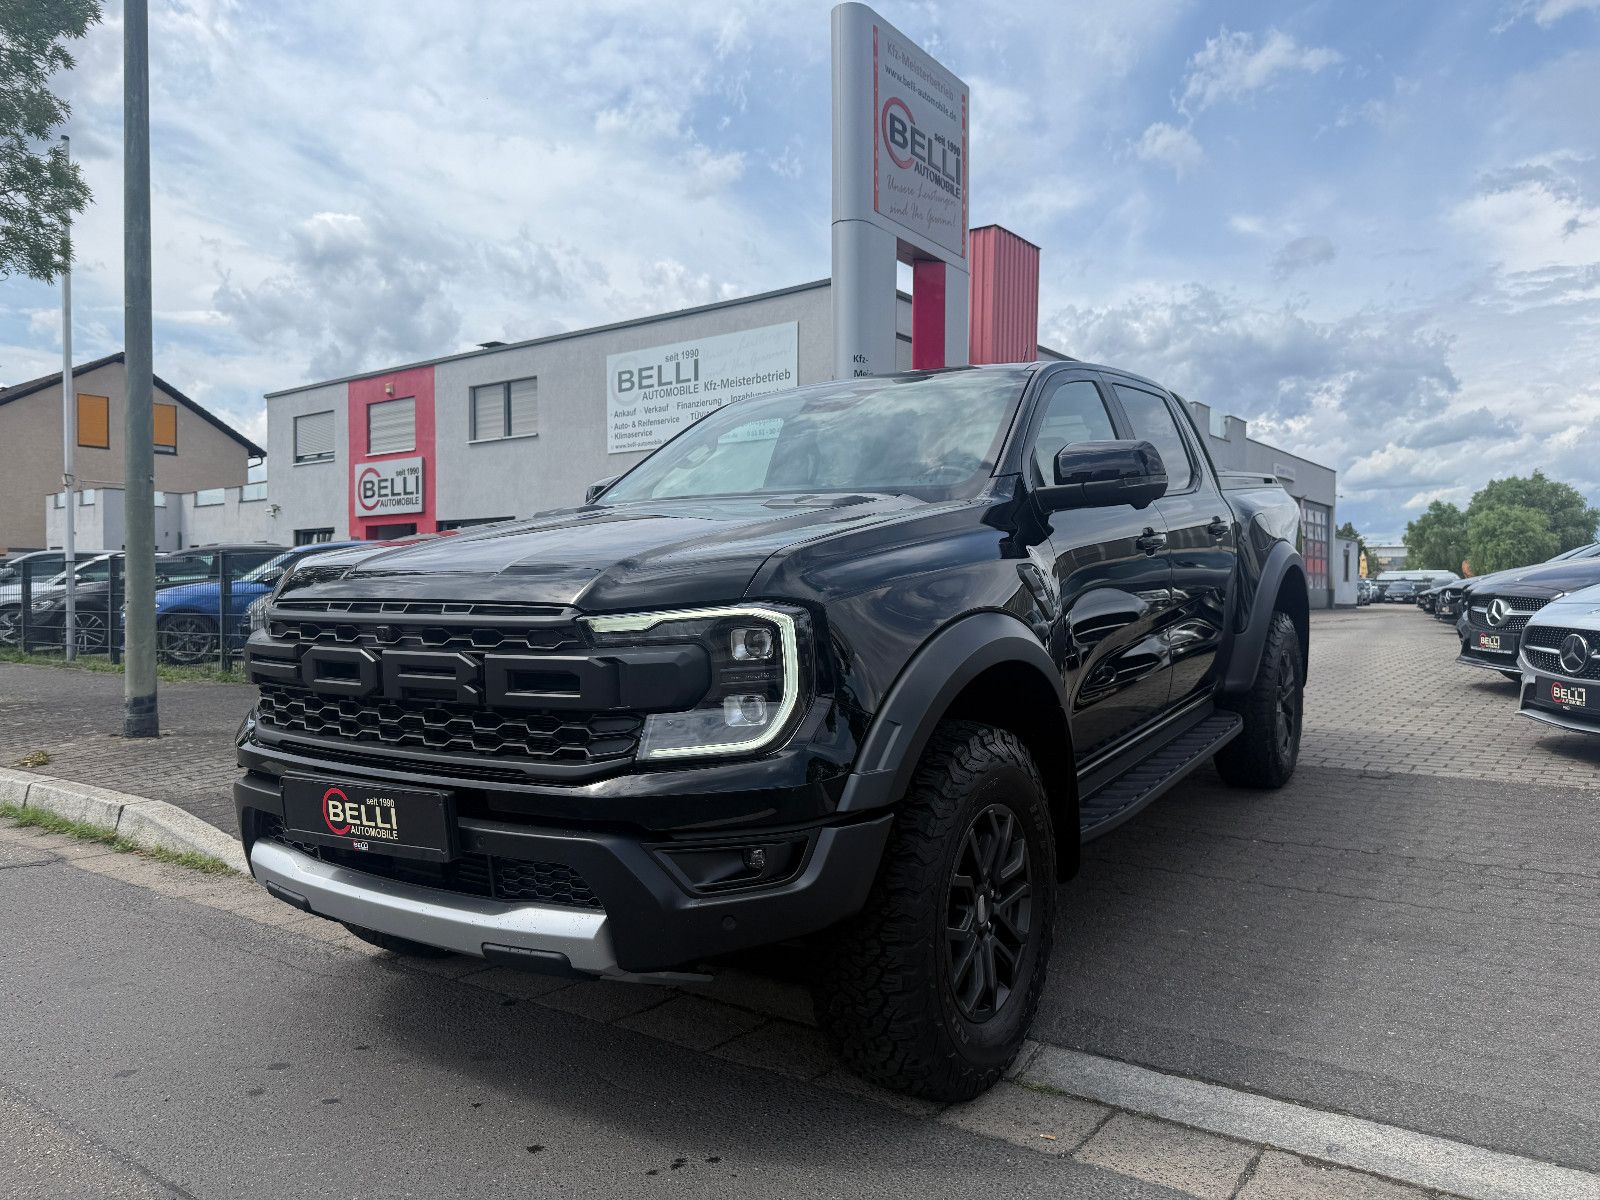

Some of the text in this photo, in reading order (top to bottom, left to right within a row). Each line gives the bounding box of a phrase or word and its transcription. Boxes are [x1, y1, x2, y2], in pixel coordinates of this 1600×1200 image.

[889, 112, 961, 186] BELLI
[914, 163, 961, 200] AUTOMOBILE
[665, 349, 699, 363] seit 1990
[617, 358, 699, 394] BELLI
[703, 368, 791, 392] Kfz-Meisterbetrieb
[642, 384, 699, 402] AUTOMOBILE
[613, 407, 637, 419] Ankauf
[643, 403, 669, 415] Verkauf
[676, 398, 722, 411] Finanzierung
[637, 416, 680, 428] Reifenservice
[614, 430, 653, 440] Klimaservice
[407, 467, 420, 475] 1990
[363, 476, 420, 499] BELLI
[380, 496, 420, 508] AUTOMOBILE
[1553, 686, 1586, 702] BELLI
[366, 797, 395, 808] seit 1990
[328, 799, 398, 830] BELLI
[350, 825, 399, 840] AUTOMOBILE
